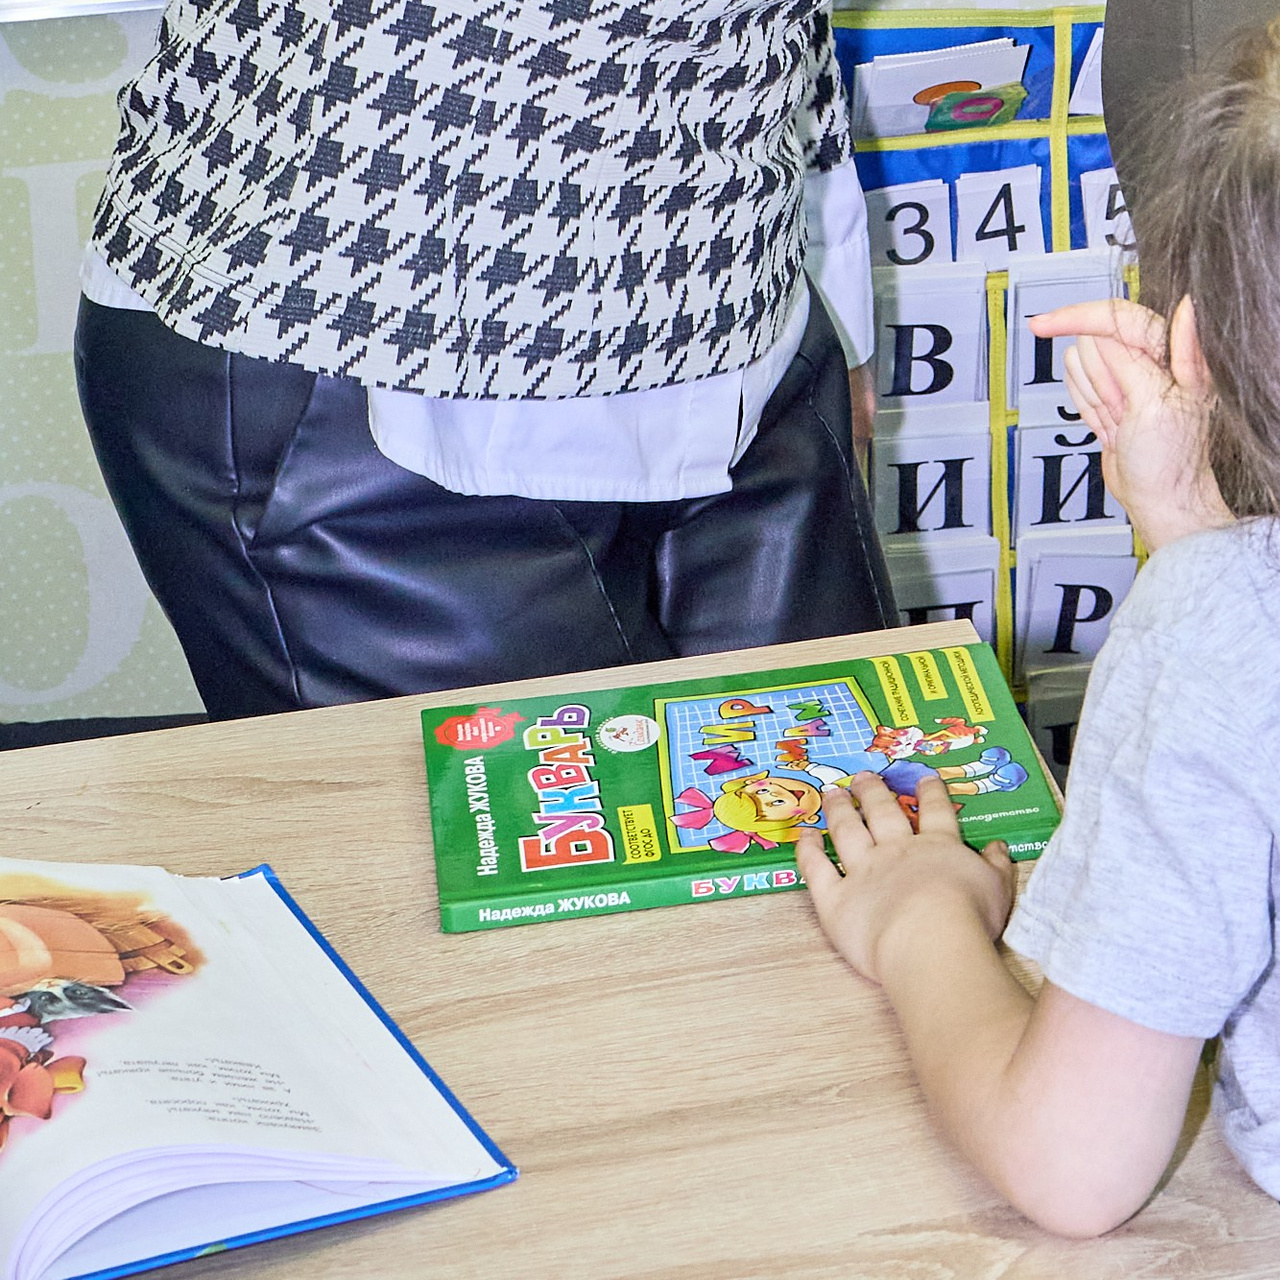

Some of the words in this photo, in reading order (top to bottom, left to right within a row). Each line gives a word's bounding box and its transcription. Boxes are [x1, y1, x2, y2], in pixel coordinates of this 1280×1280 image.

[884, 201, 935, 266] 3
[974, 182, 1027, 253] 4
[881, 323, 955, 398] В
[887, 456, 975, 535] И
[1030, 432, 1116, 527] Й
[1042, 582, 1114, 656] Р
[463, 754, 490, 814] ЖУКОВА
[517, 704, 616, 873] БУКВАРЬ
[475, 813, 499, 877] Надежда
[622, 808, 642, 861] СООТВЕТСТВУЕТ
[644, 838, 656, 859] ФГОС
[478, 900, 555, 924] Надежда
[557, 891, 631, 914] ЖУКОВА
[690, 868, 806, 899] БУКВ
